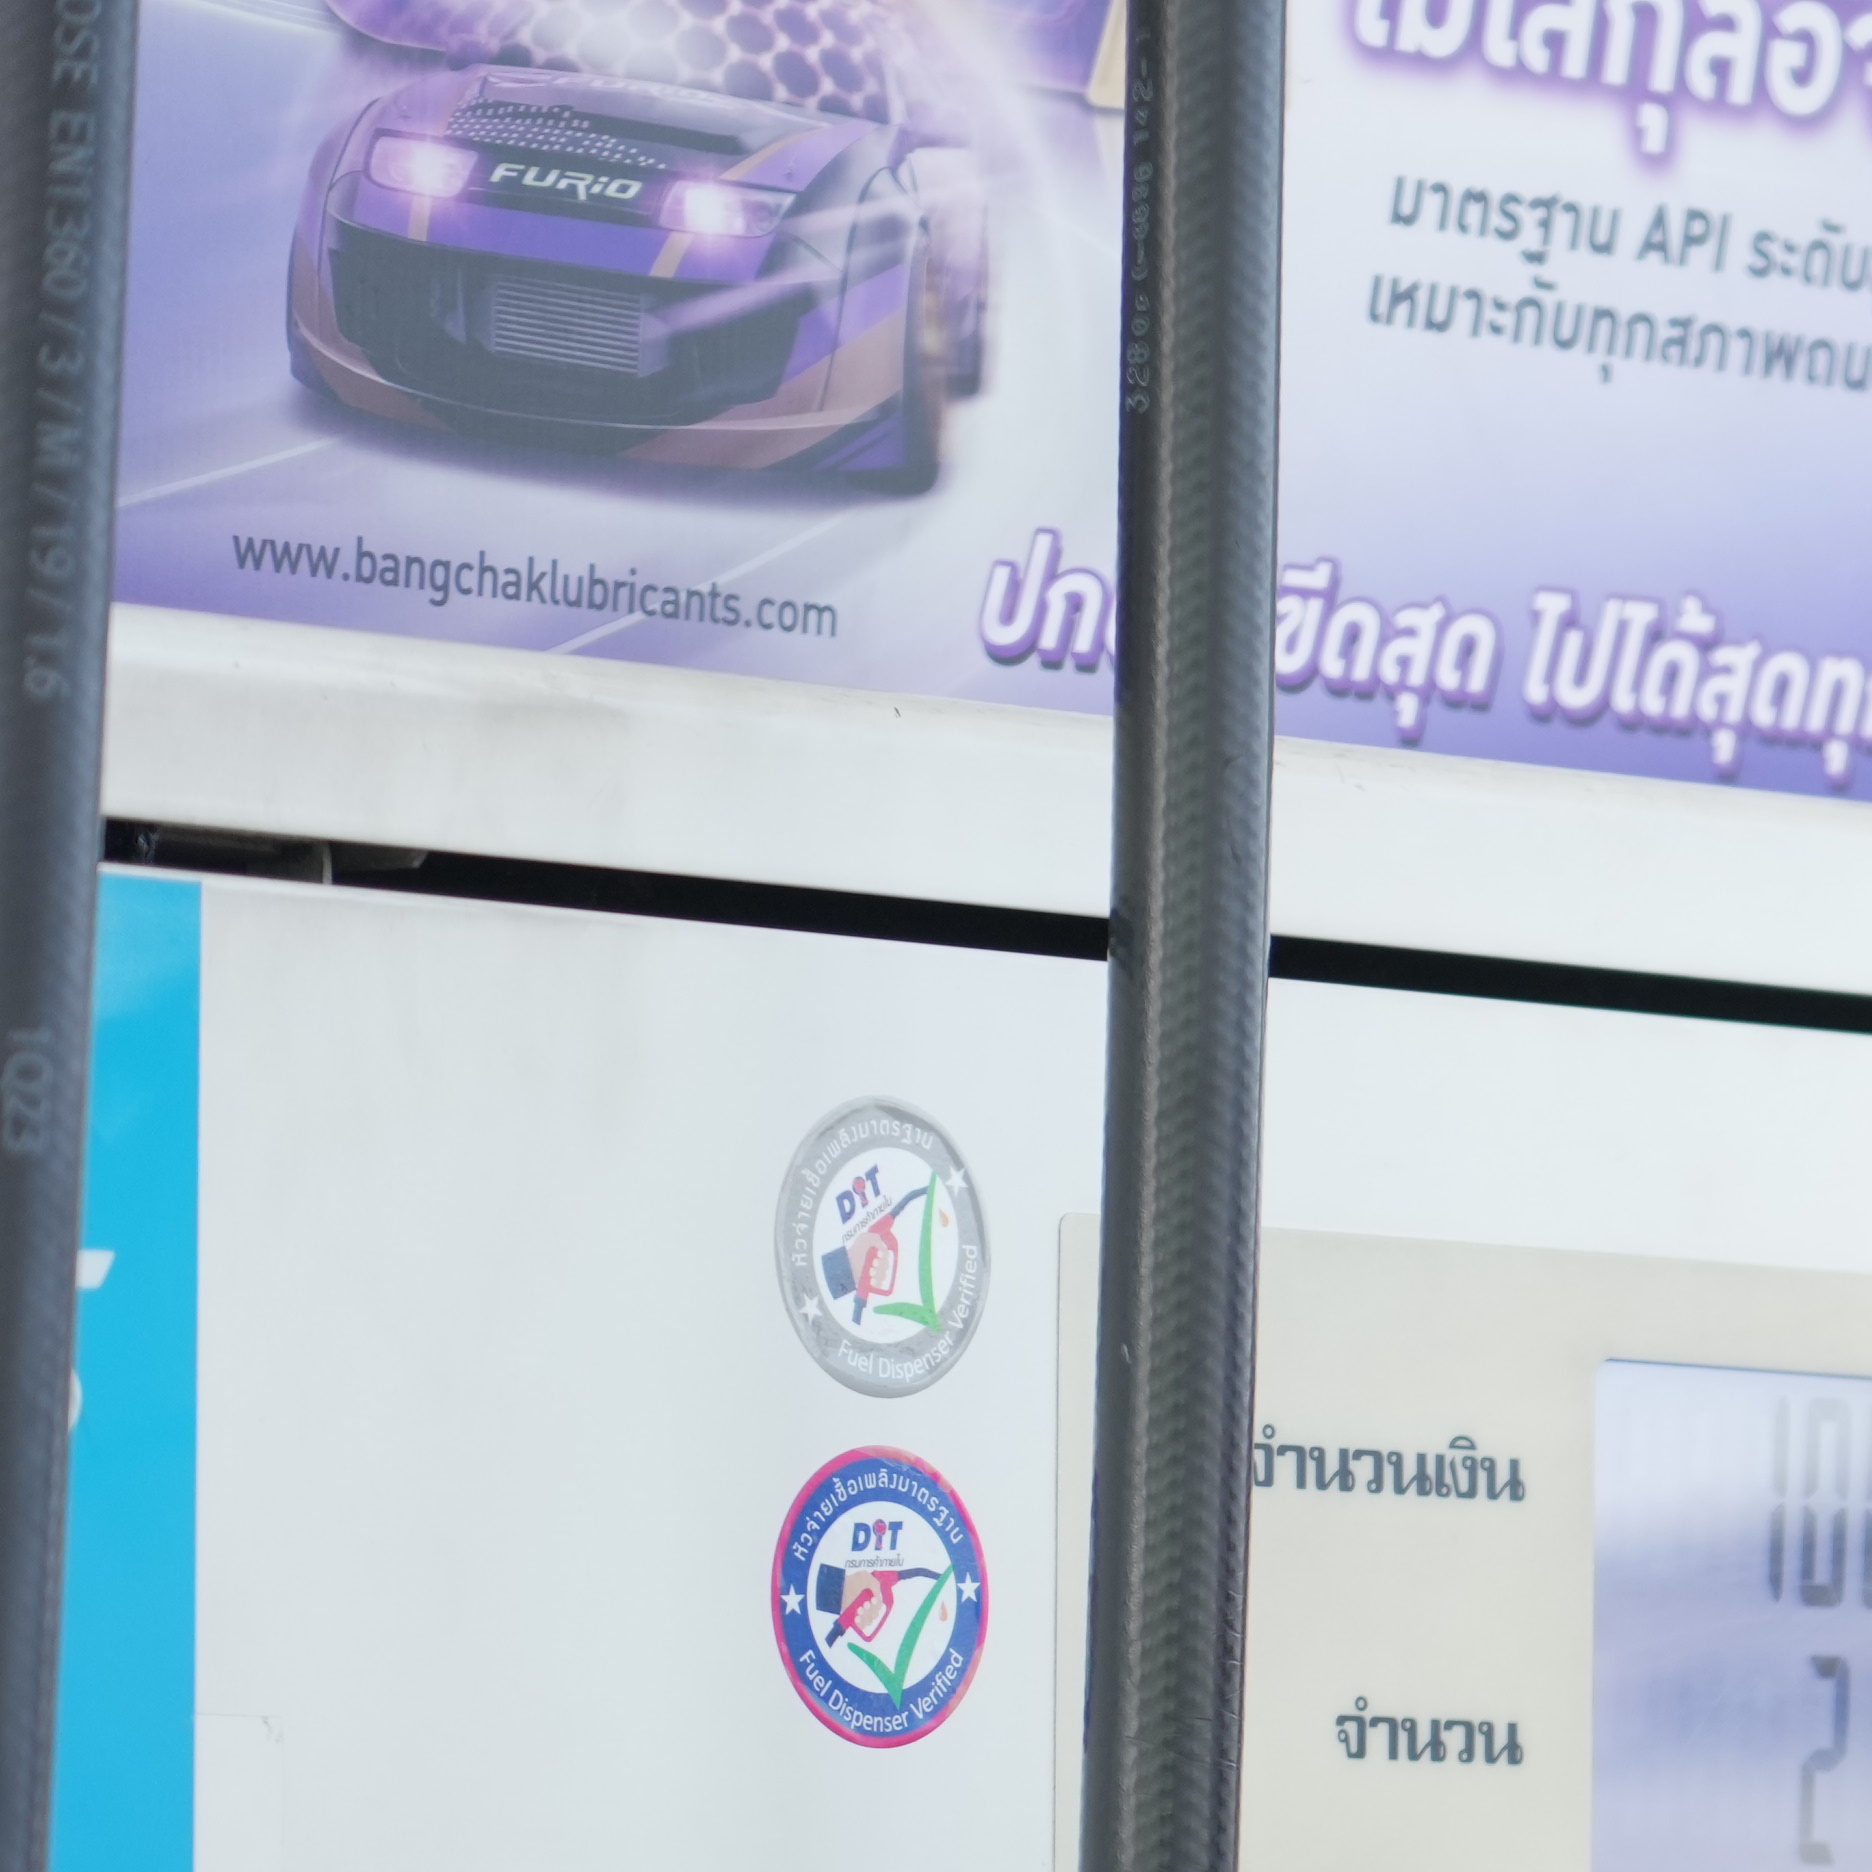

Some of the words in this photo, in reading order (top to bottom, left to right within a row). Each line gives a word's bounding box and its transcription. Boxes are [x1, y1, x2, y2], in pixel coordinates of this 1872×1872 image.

[1390, 175, 1623, 265] มาตรฐาน
[1635, 204, 1734, 273] API
[232, 534, 838, 638] www.bangchaklubricants.com
[837, 1338, 874, 1376] Fuel
[877, 1330, 955, 1384] Dispenser
[947, 1243, 979, 1330] Verified
[1253, 1423, 1526, 1502] จำนวนเงิน
[793, 1468, 965, 1562] หัวจ่ายเชื้อเพลิงมาตรฐาน
[799, 1648, 832, 1698] Fuel
[828, 1689, 909, 1733] Dispenser
[909, 1647, 965, 1720] Verified
[1336, 1695, 1524, 1766] จำนวน
